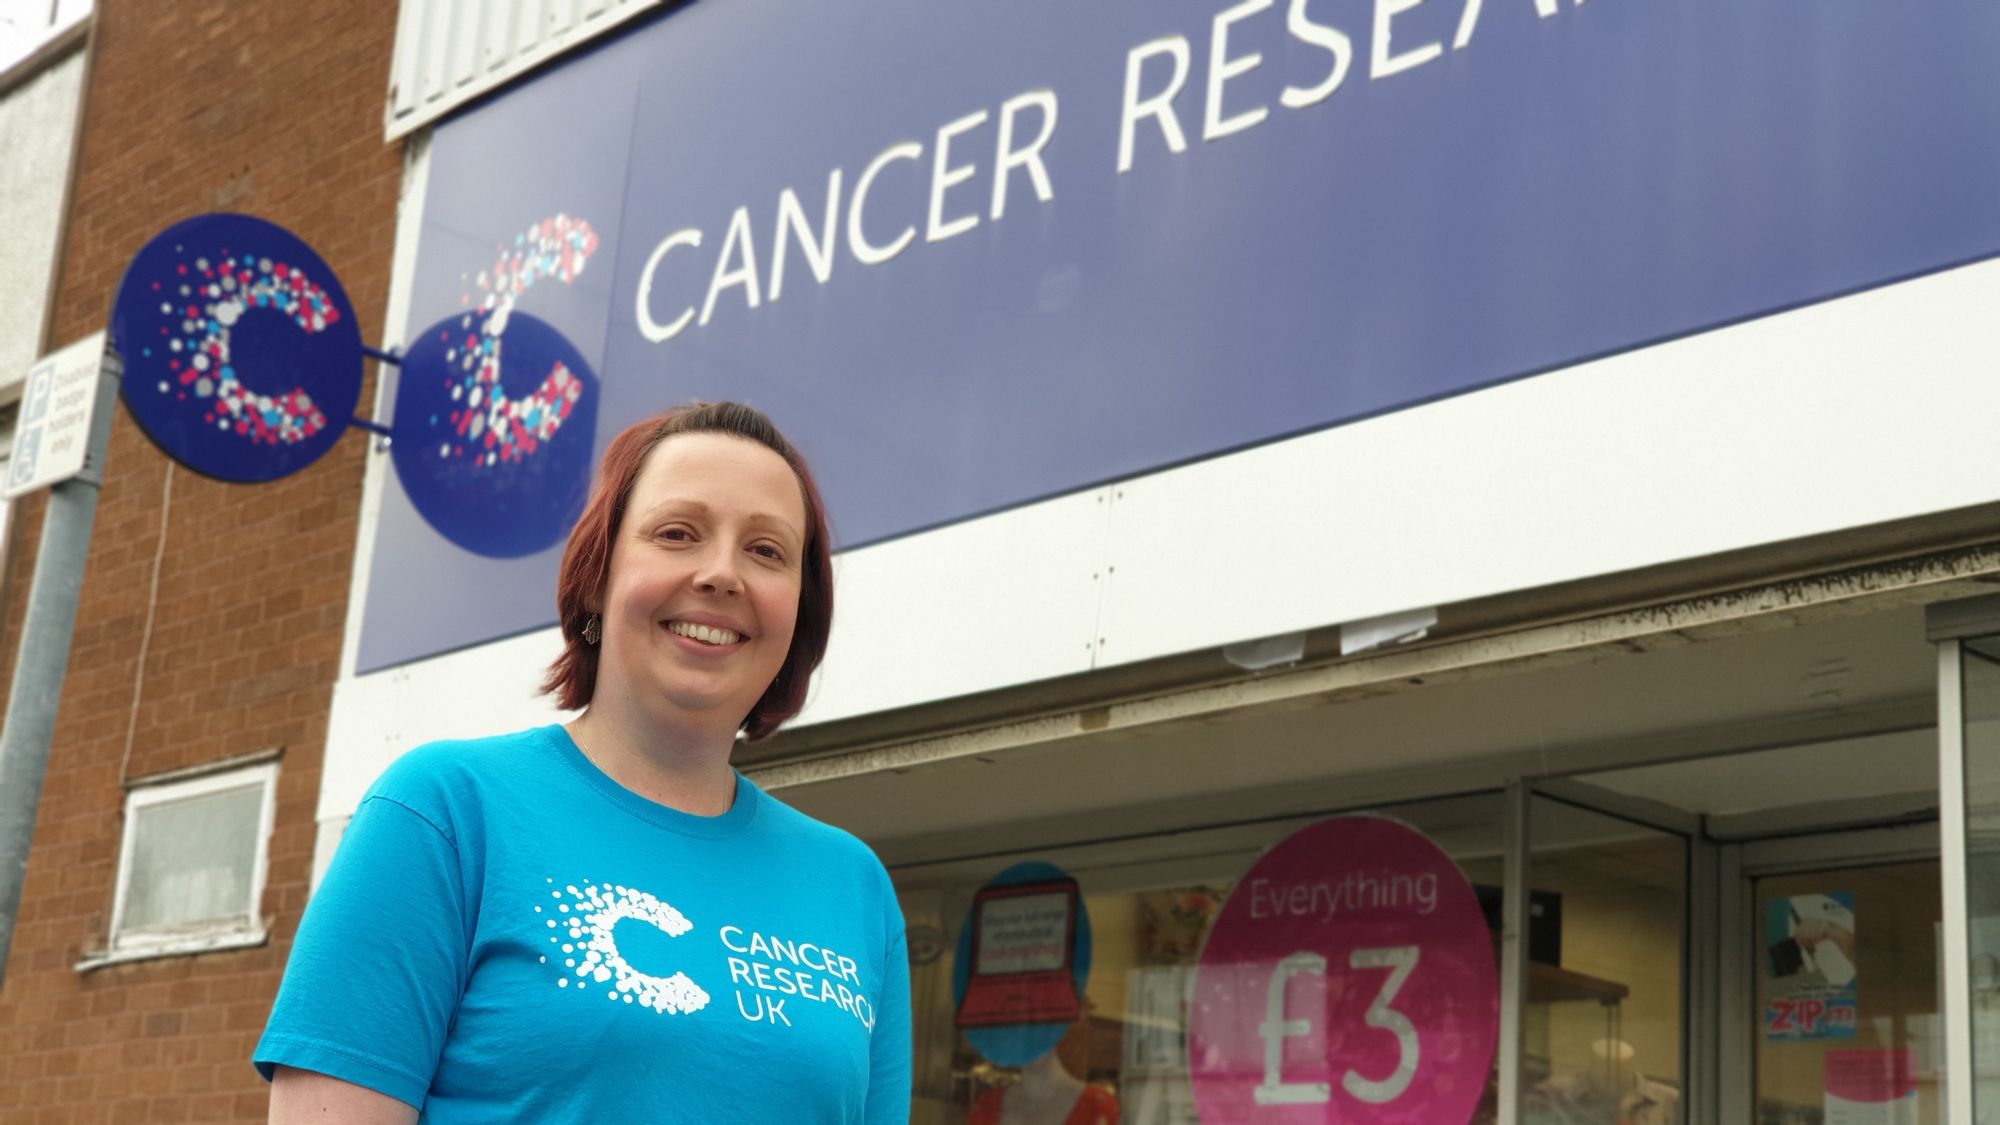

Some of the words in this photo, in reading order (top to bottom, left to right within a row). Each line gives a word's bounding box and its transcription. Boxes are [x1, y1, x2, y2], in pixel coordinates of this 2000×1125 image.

[635, 90, 1057, 343] CANCER
[1117, 0, 1583, 173] RESE
[1250, 869, 1437, 923] Everything
[719, 925, 860, 986] CANCER
[735, 990, 791, 1027] UK
[1254, 945, 1420, 1105] £3
